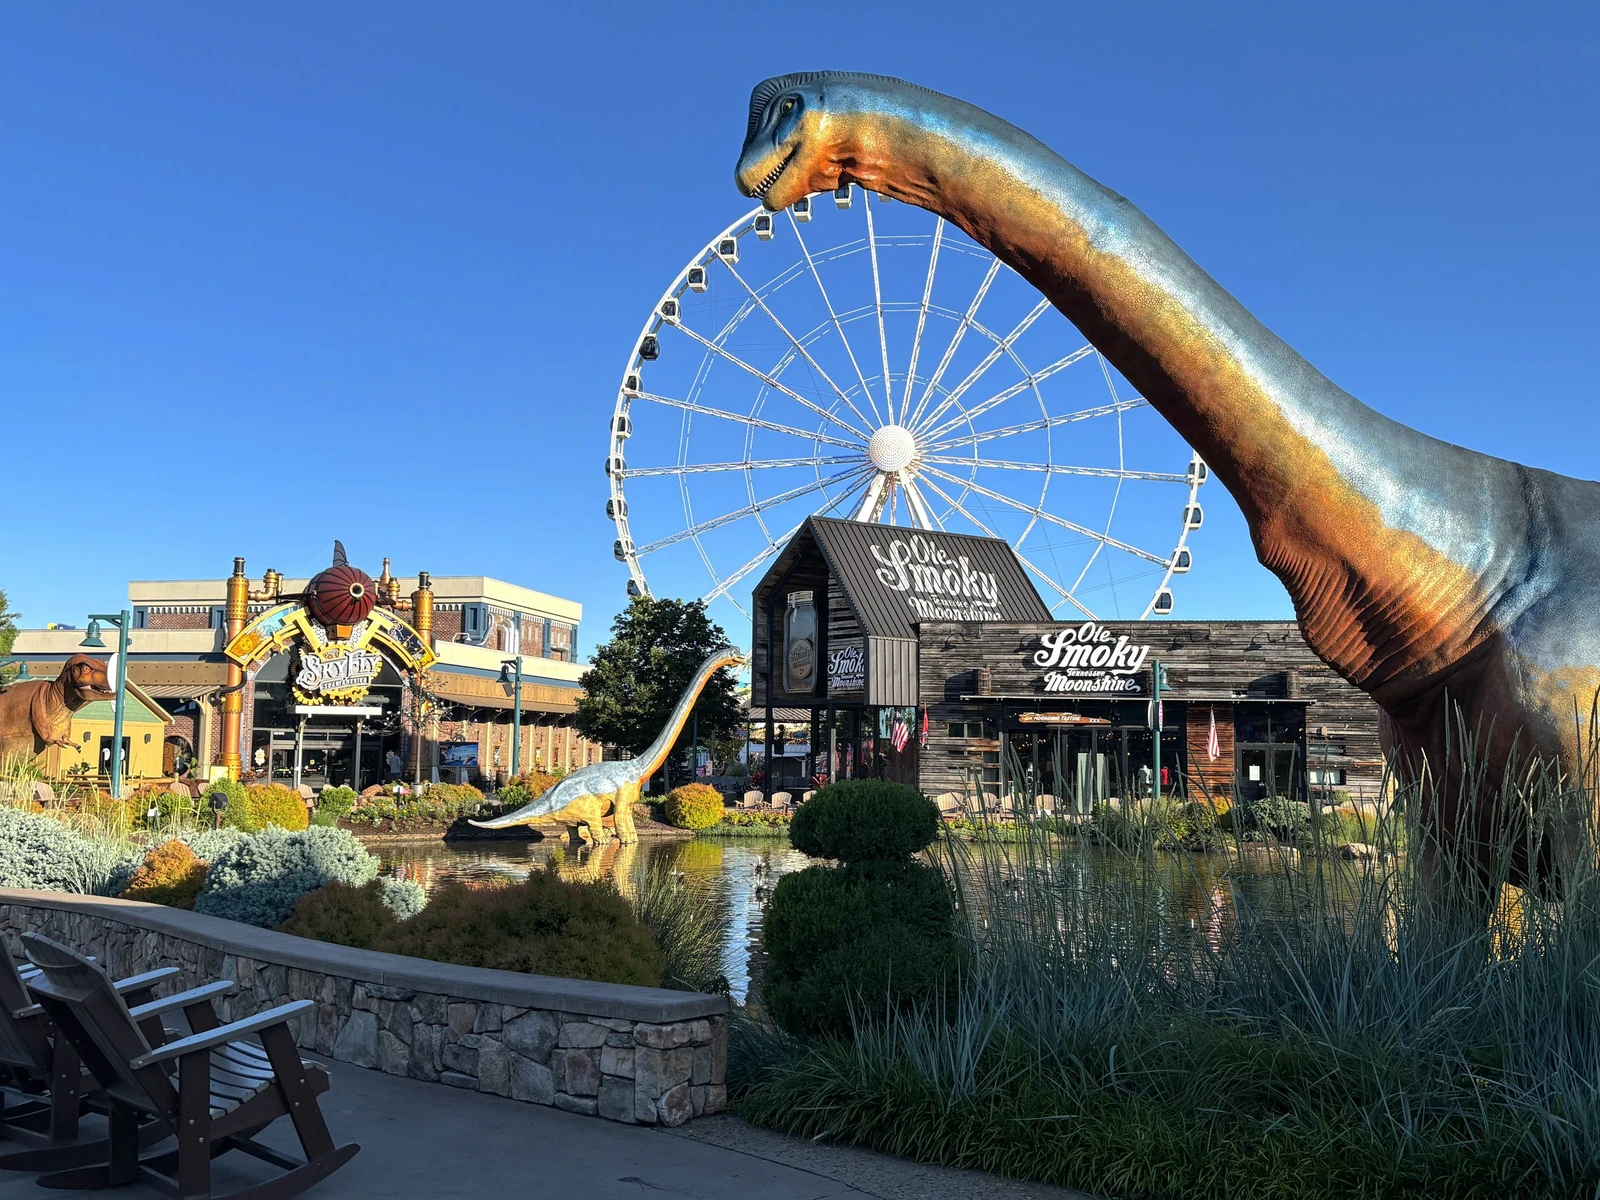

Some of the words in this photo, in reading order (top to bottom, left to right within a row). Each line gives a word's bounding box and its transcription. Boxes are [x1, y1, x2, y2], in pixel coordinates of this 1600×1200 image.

[910, 534, 959, 569] Ole
[870, 539, 1001, 608] Smoky
[1077, 621, 1117, 644] Ole
[827, 650, 865, 678] Smok
[844, 645, 859, 659] Ole
[1033, 628, 1151, 676] Smoky
[1043, 671, 1142, 693] Moonshine
[1066, 667, 1106, 677] Tennessee
